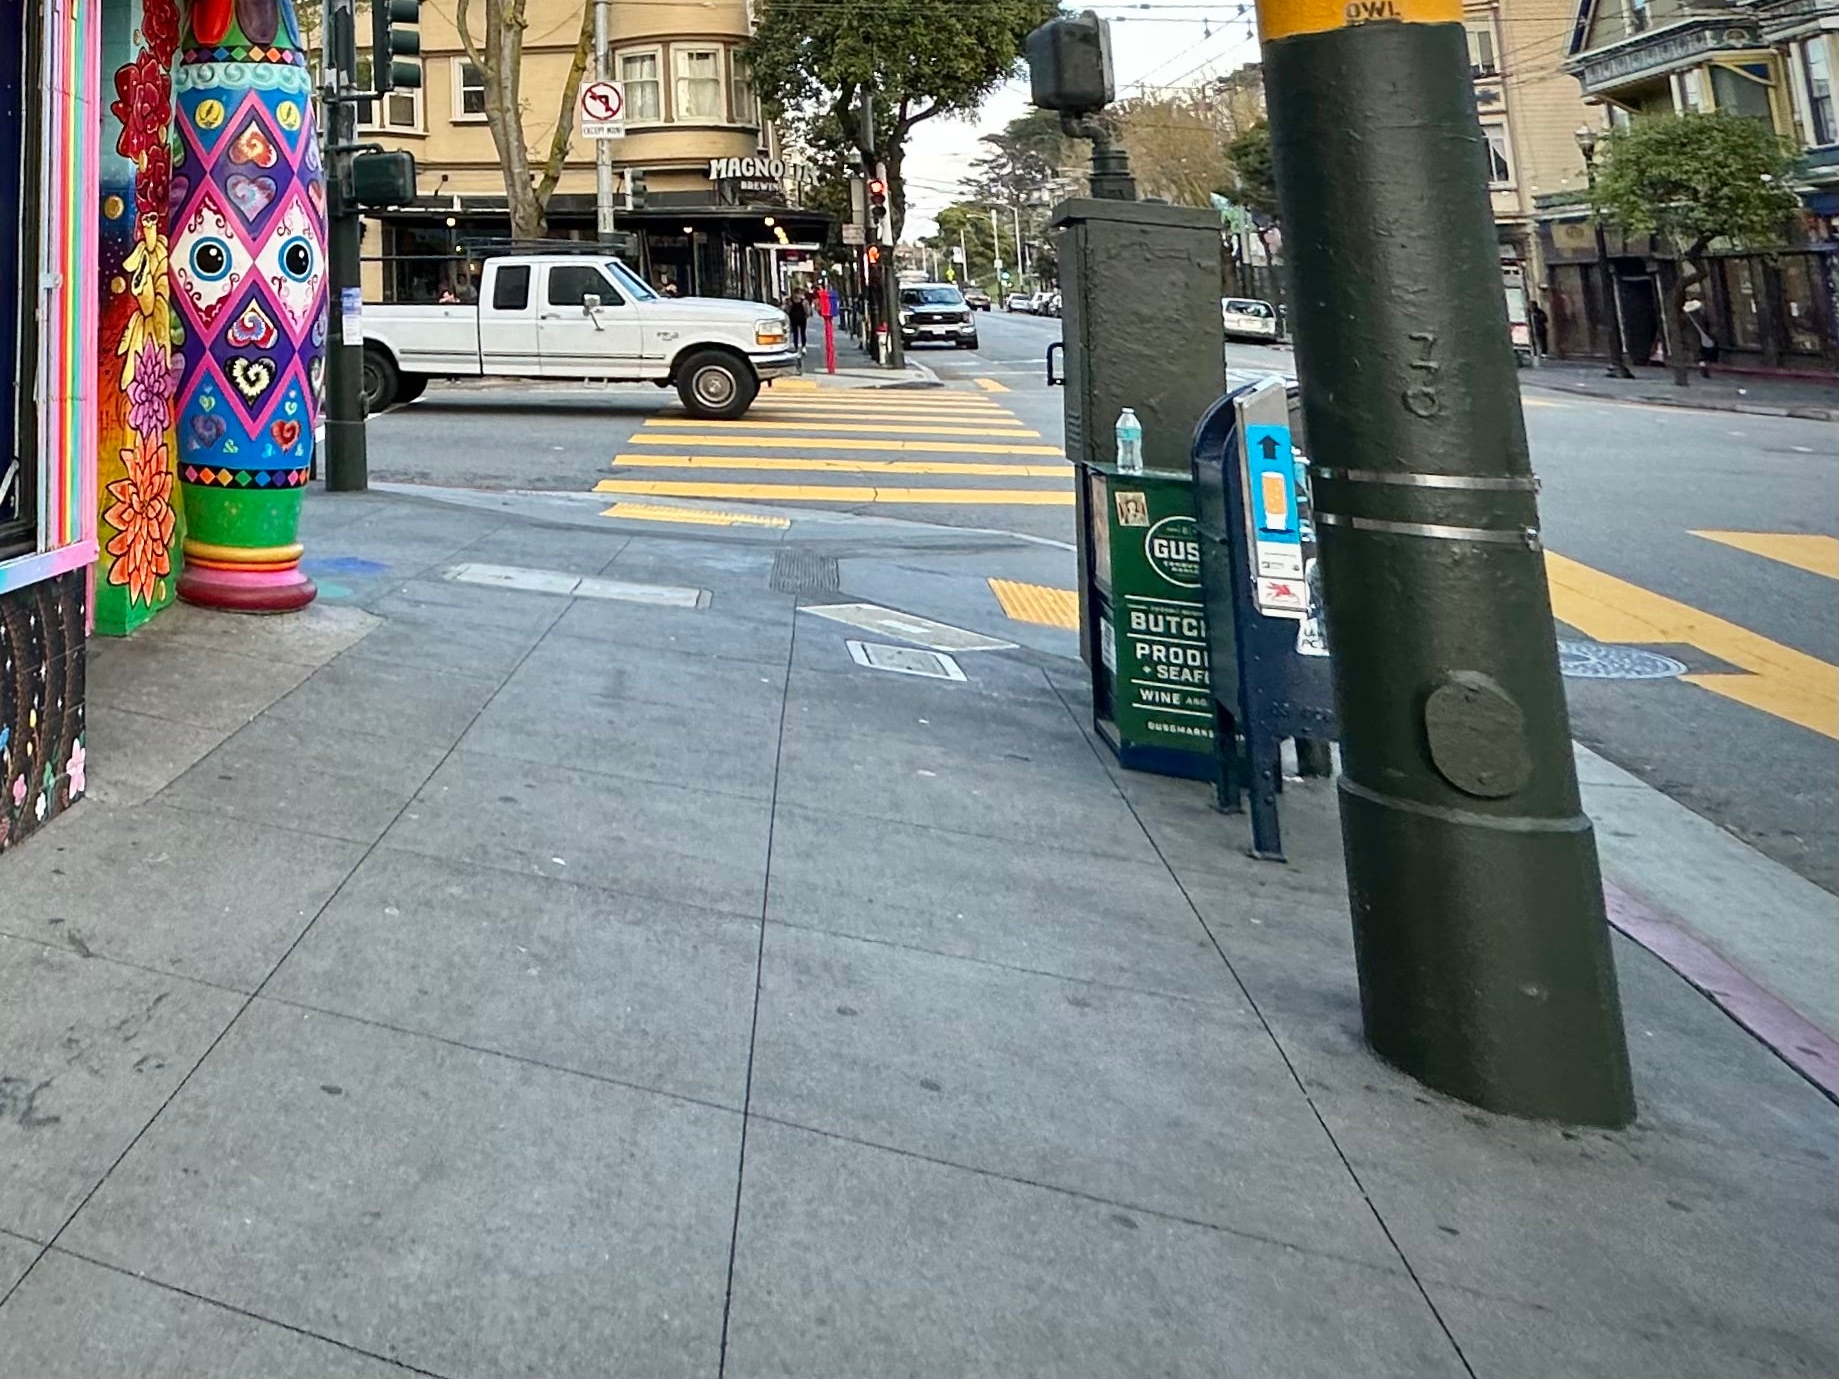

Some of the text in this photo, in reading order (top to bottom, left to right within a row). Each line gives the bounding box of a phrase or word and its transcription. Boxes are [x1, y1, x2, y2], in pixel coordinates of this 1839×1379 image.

[1346, 1, 1401, 19] OWL
[1130, 611, 1206, 638] BUTC
[1135, 642, 1209, 668] PROD
[1139, 688, 1181, 705] WINE
